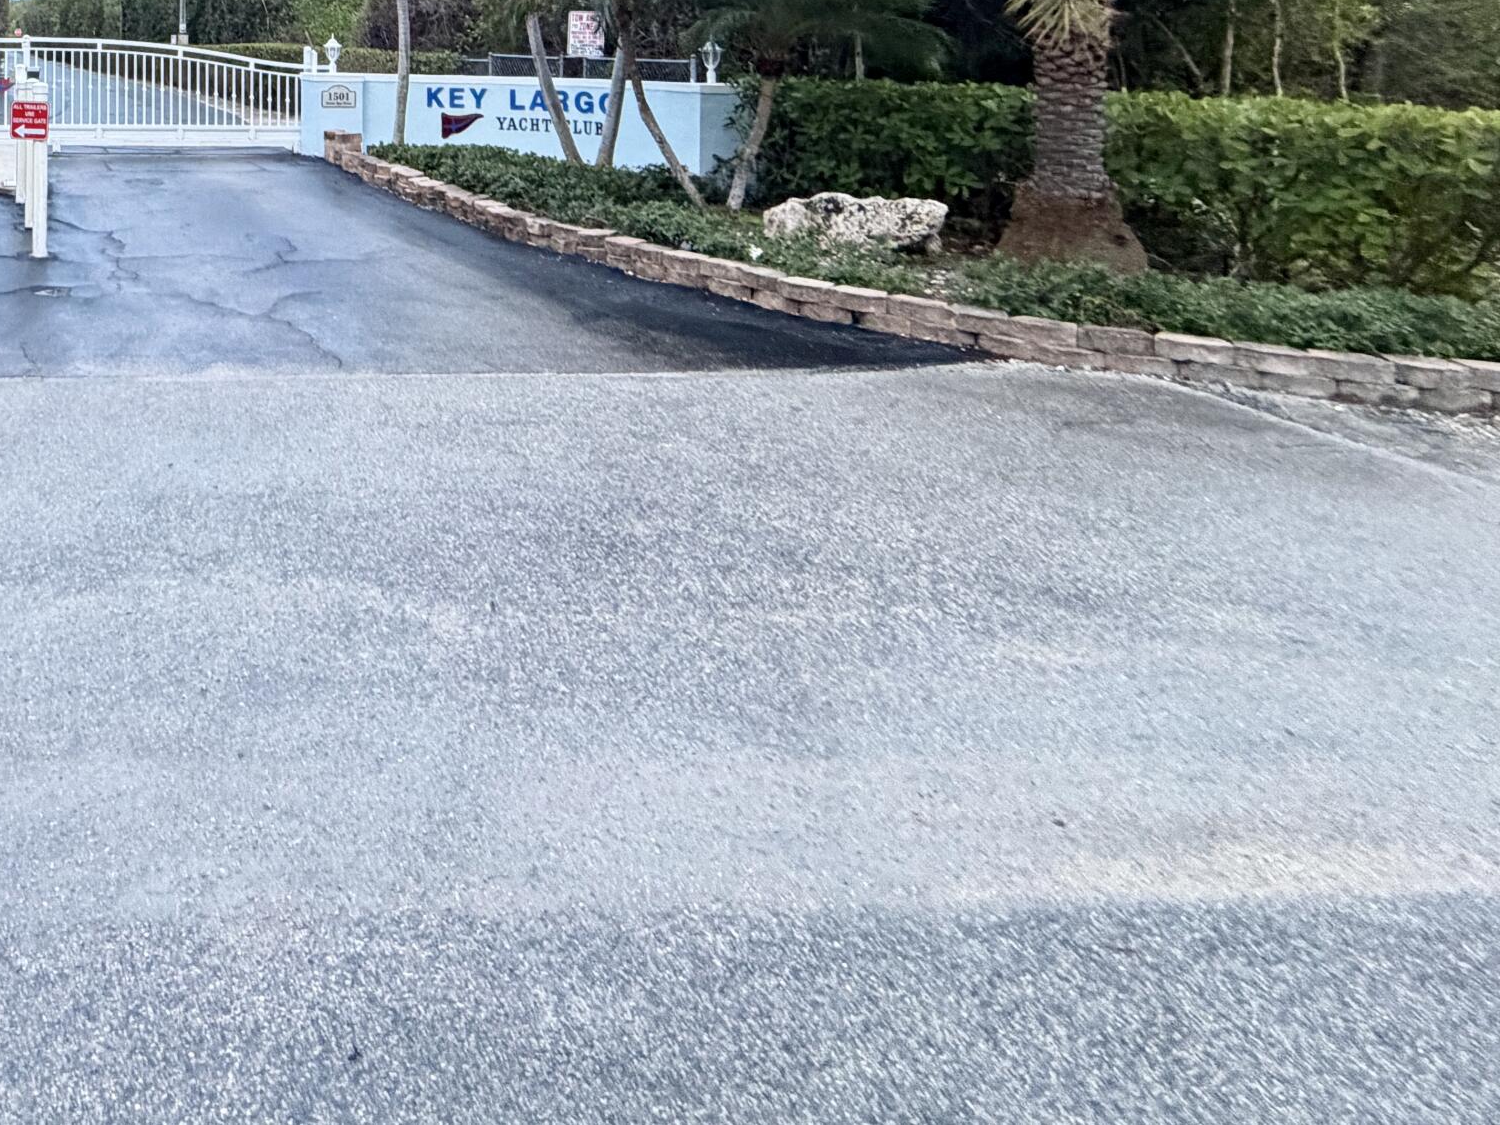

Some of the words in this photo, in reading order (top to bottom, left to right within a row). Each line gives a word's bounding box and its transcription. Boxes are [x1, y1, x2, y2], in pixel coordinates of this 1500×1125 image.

[328, 92, 349, 101] 1501
[426, 86, 487, 109] KEY
[495, 116, 552, 132] YACHT
[565, 119, 604, 136] LUB
